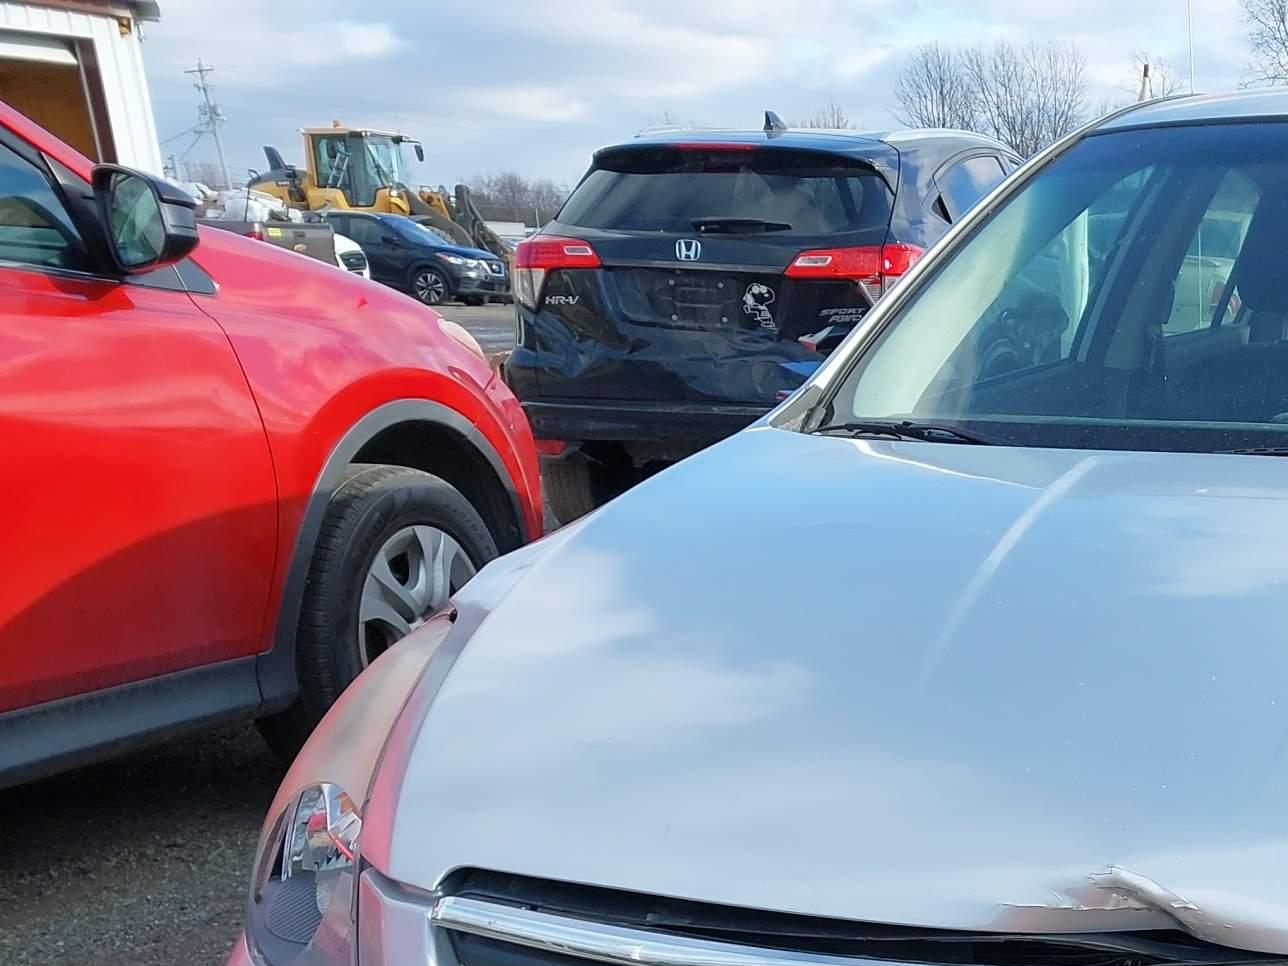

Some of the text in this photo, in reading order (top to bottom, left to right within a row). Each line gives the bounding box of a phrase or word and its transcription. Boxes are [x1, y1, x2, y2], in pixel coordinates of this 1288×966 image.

[545, 295, 579, 305] HR-V
[819, 307, 866, 317] SPORT
[828, 314, 863, 323] AWD
